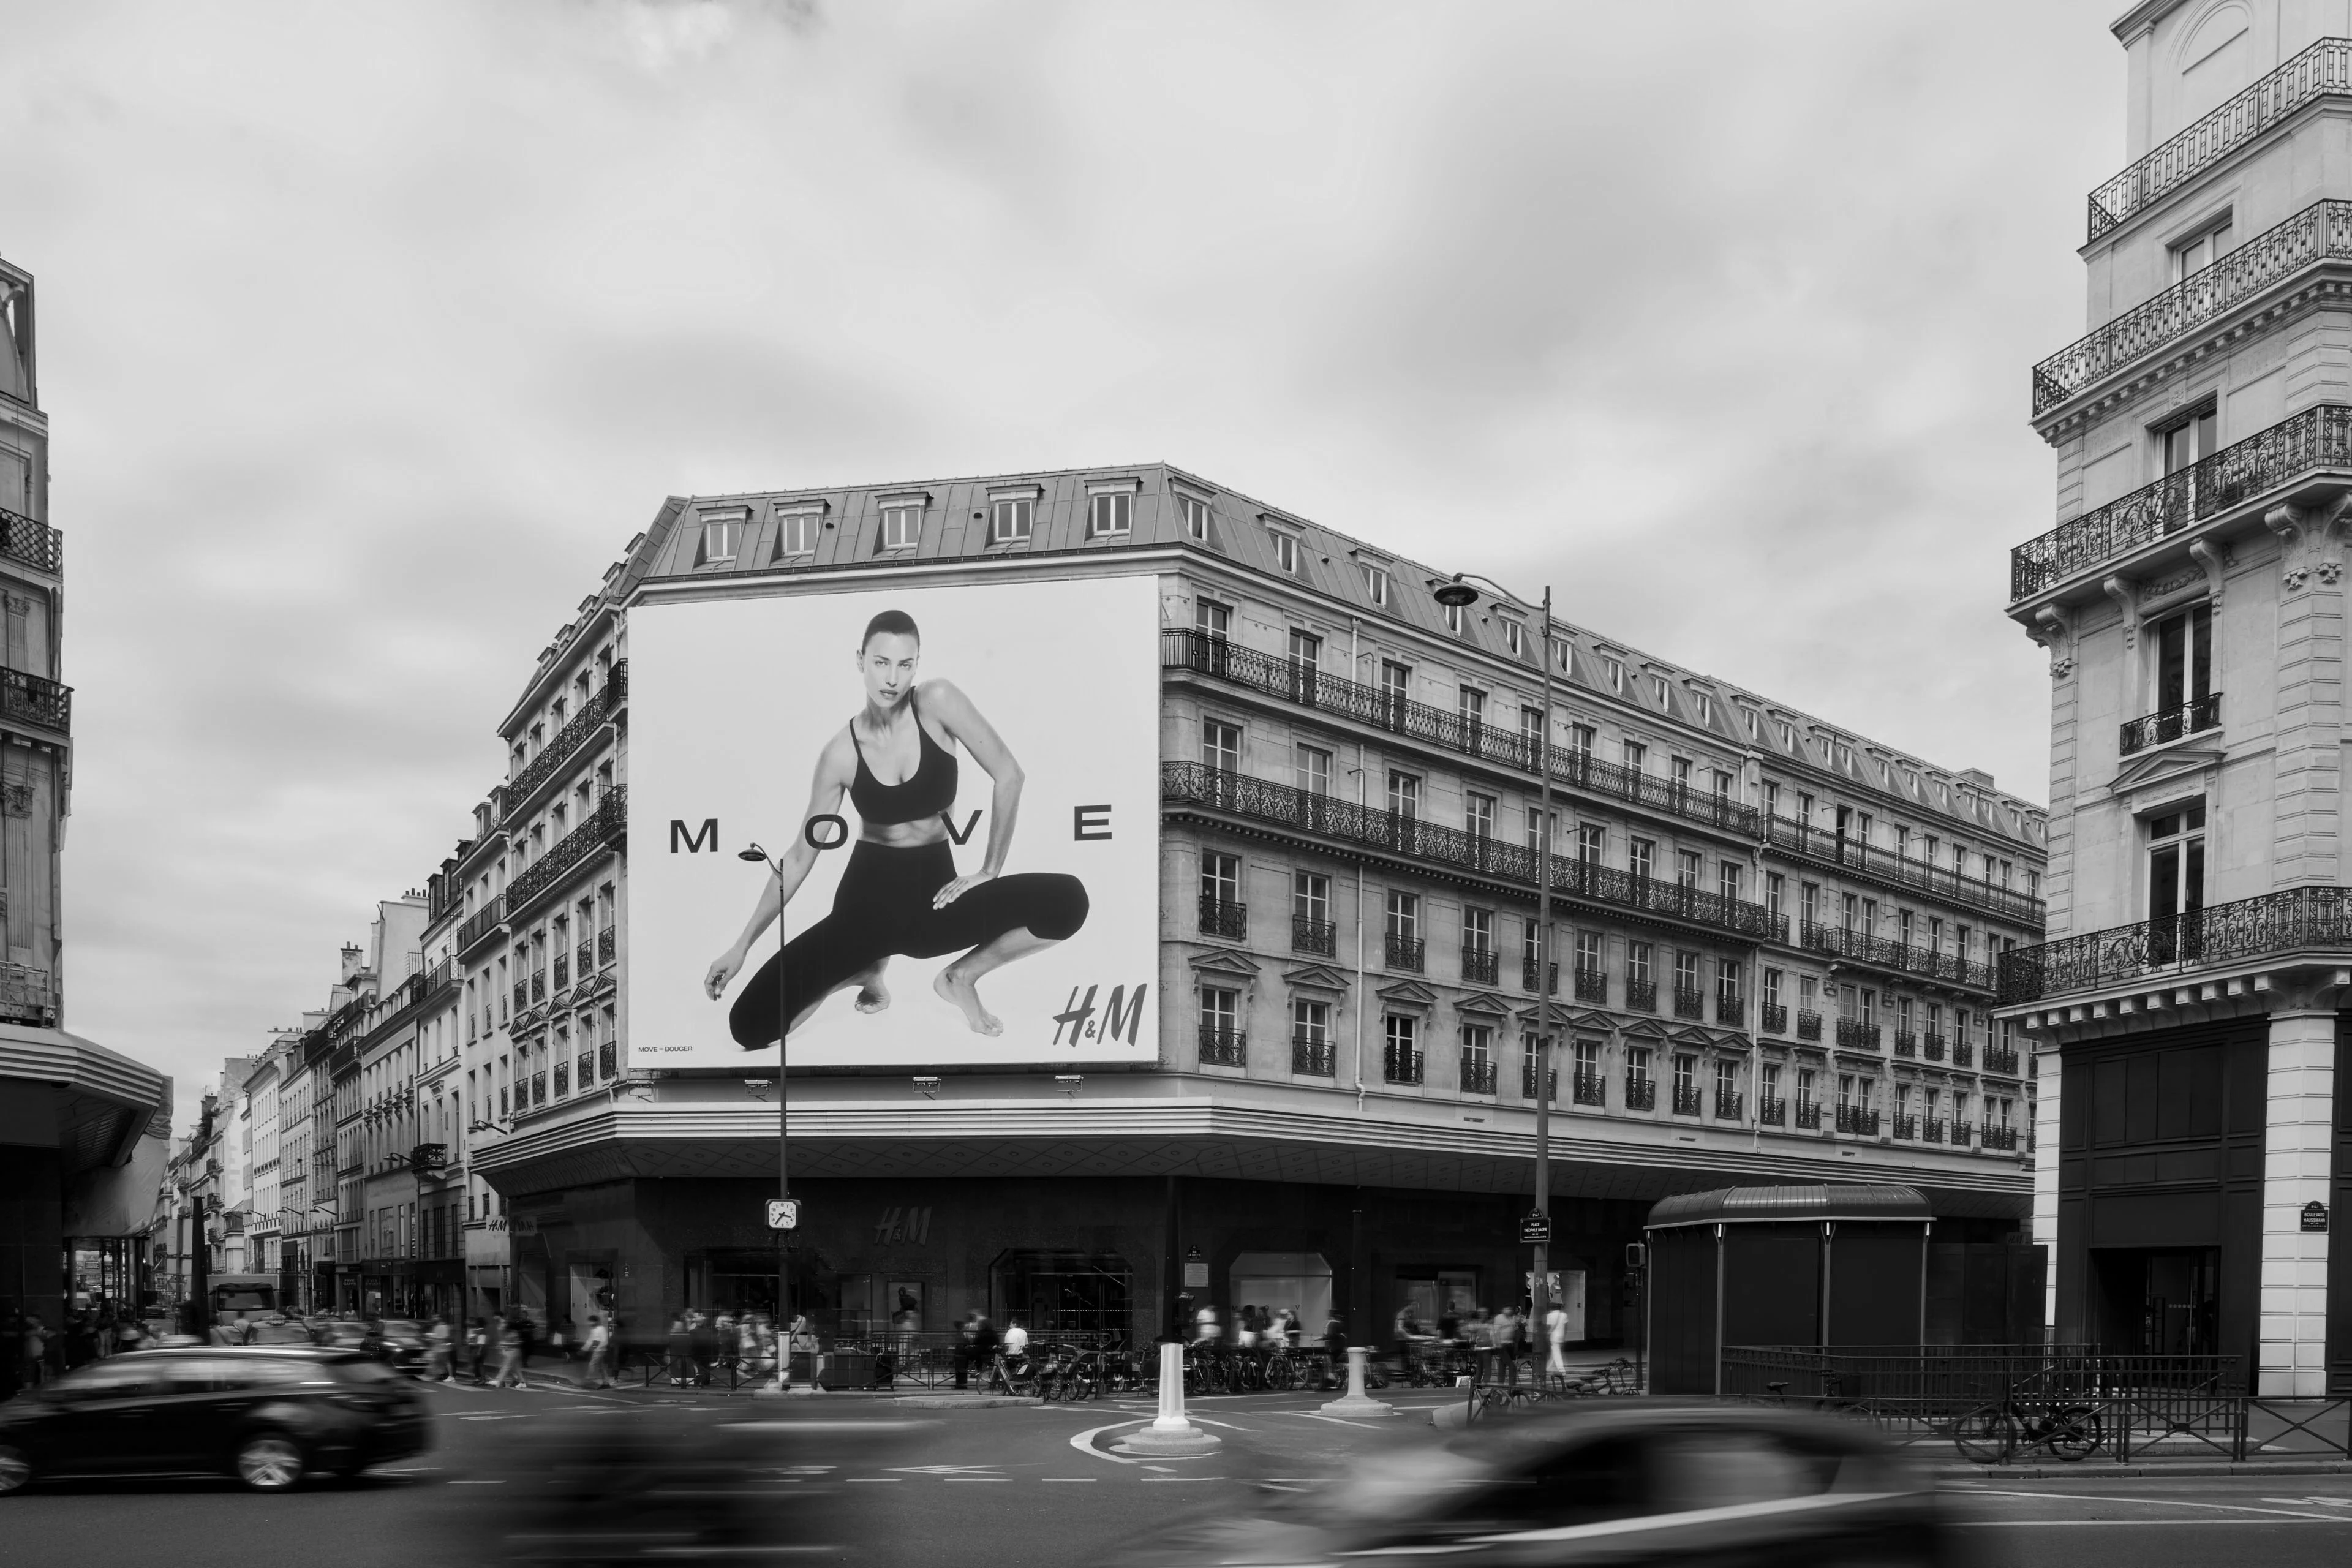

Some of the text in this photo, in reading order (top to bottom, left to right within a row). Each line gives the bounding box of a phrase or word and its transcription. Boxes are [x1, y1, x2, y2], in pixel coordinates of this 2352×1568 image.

[671, 804, 1112, 853] MOVE
[1053, 983, 1147, 1048] H&M
[489, 1219, 507, 1232] H&M
[873, 1206, 933, 1246] H&M
